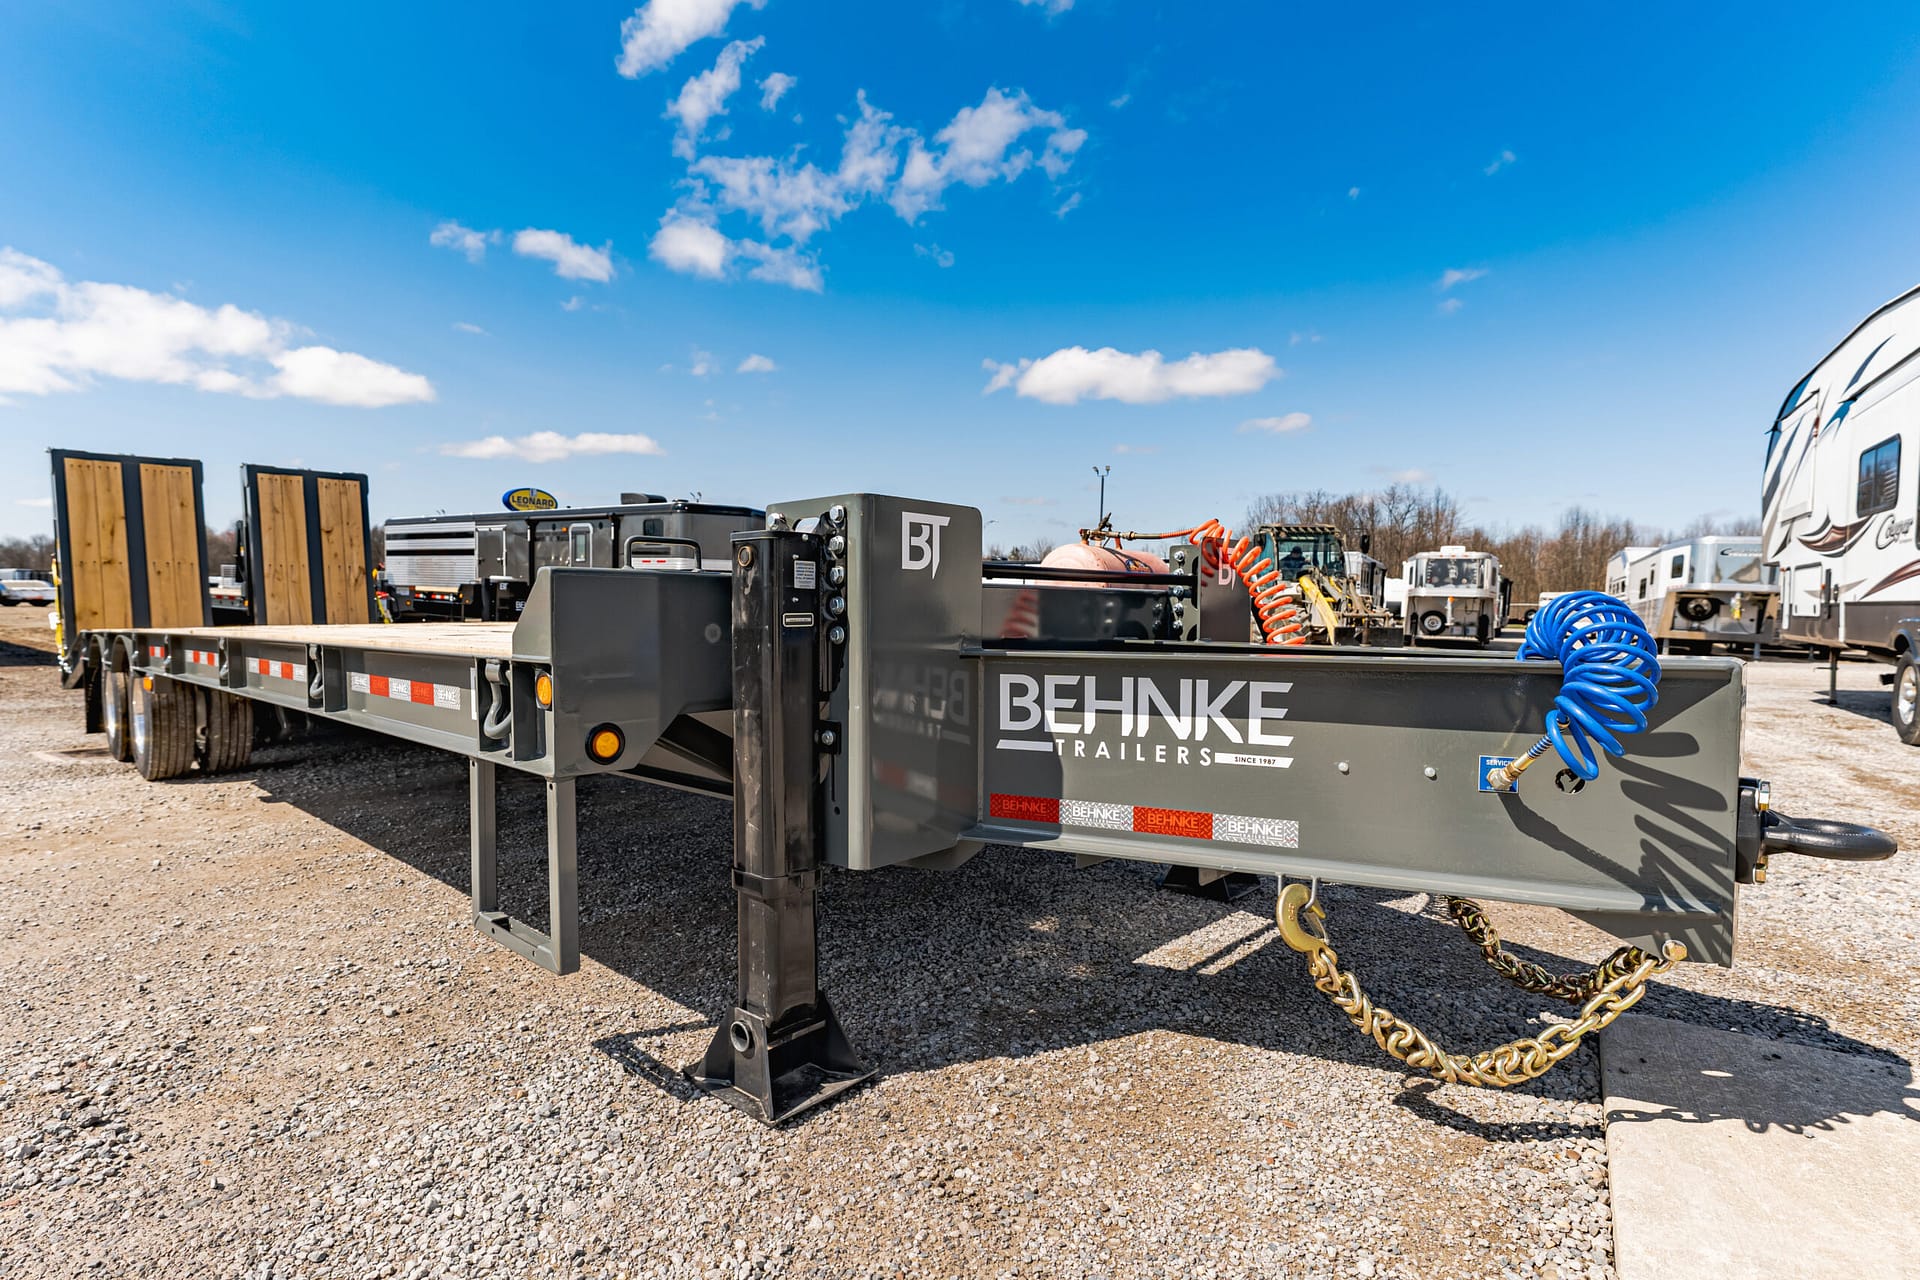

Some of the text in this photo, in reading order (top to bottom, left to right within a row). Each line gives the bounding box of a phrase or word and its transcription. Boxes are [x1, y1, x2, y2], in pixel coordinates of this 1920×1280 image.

[511, 495, 554, 507] LEONARD
[901, 511, 950, 580] BT
[999, 673, 1294, 747] BEHNKE
[1055, 738, 1212, 767] TRAILERS
[1234, 756, 1276, 765] SINCE 1987
[1485, 759, 1511, 768] SERVIC
[1002, 799, 1047, 814] BEHNKE
[1072, 805, 1121, 821] BEHNKE
[1147, 813, 1199, 829] BEHNKE
[1227, 821, 1284, 837] BEHNKE
